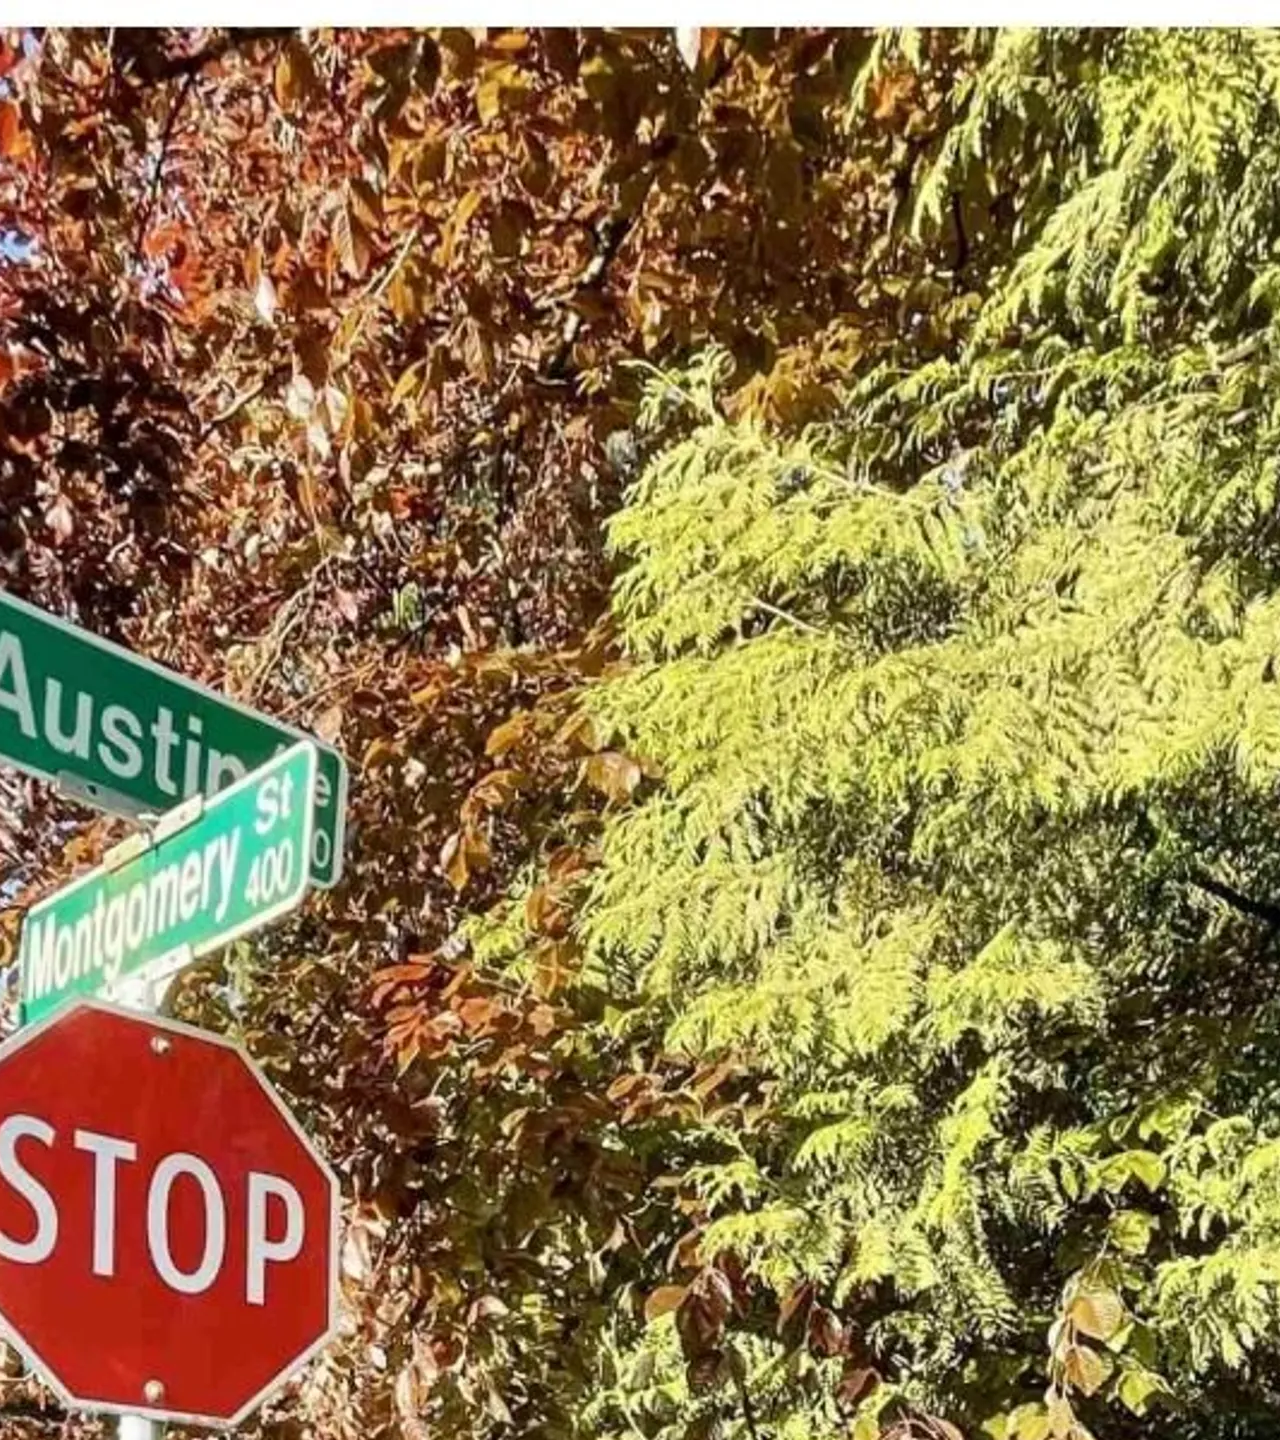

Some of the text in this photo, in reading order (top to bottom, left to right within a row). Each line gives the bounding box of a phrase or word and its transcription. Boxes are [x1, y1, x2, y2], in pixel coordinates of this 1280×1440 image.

[26, 770, 295, 1000] Montgomery St
[244, 837, 294, 903] 400
